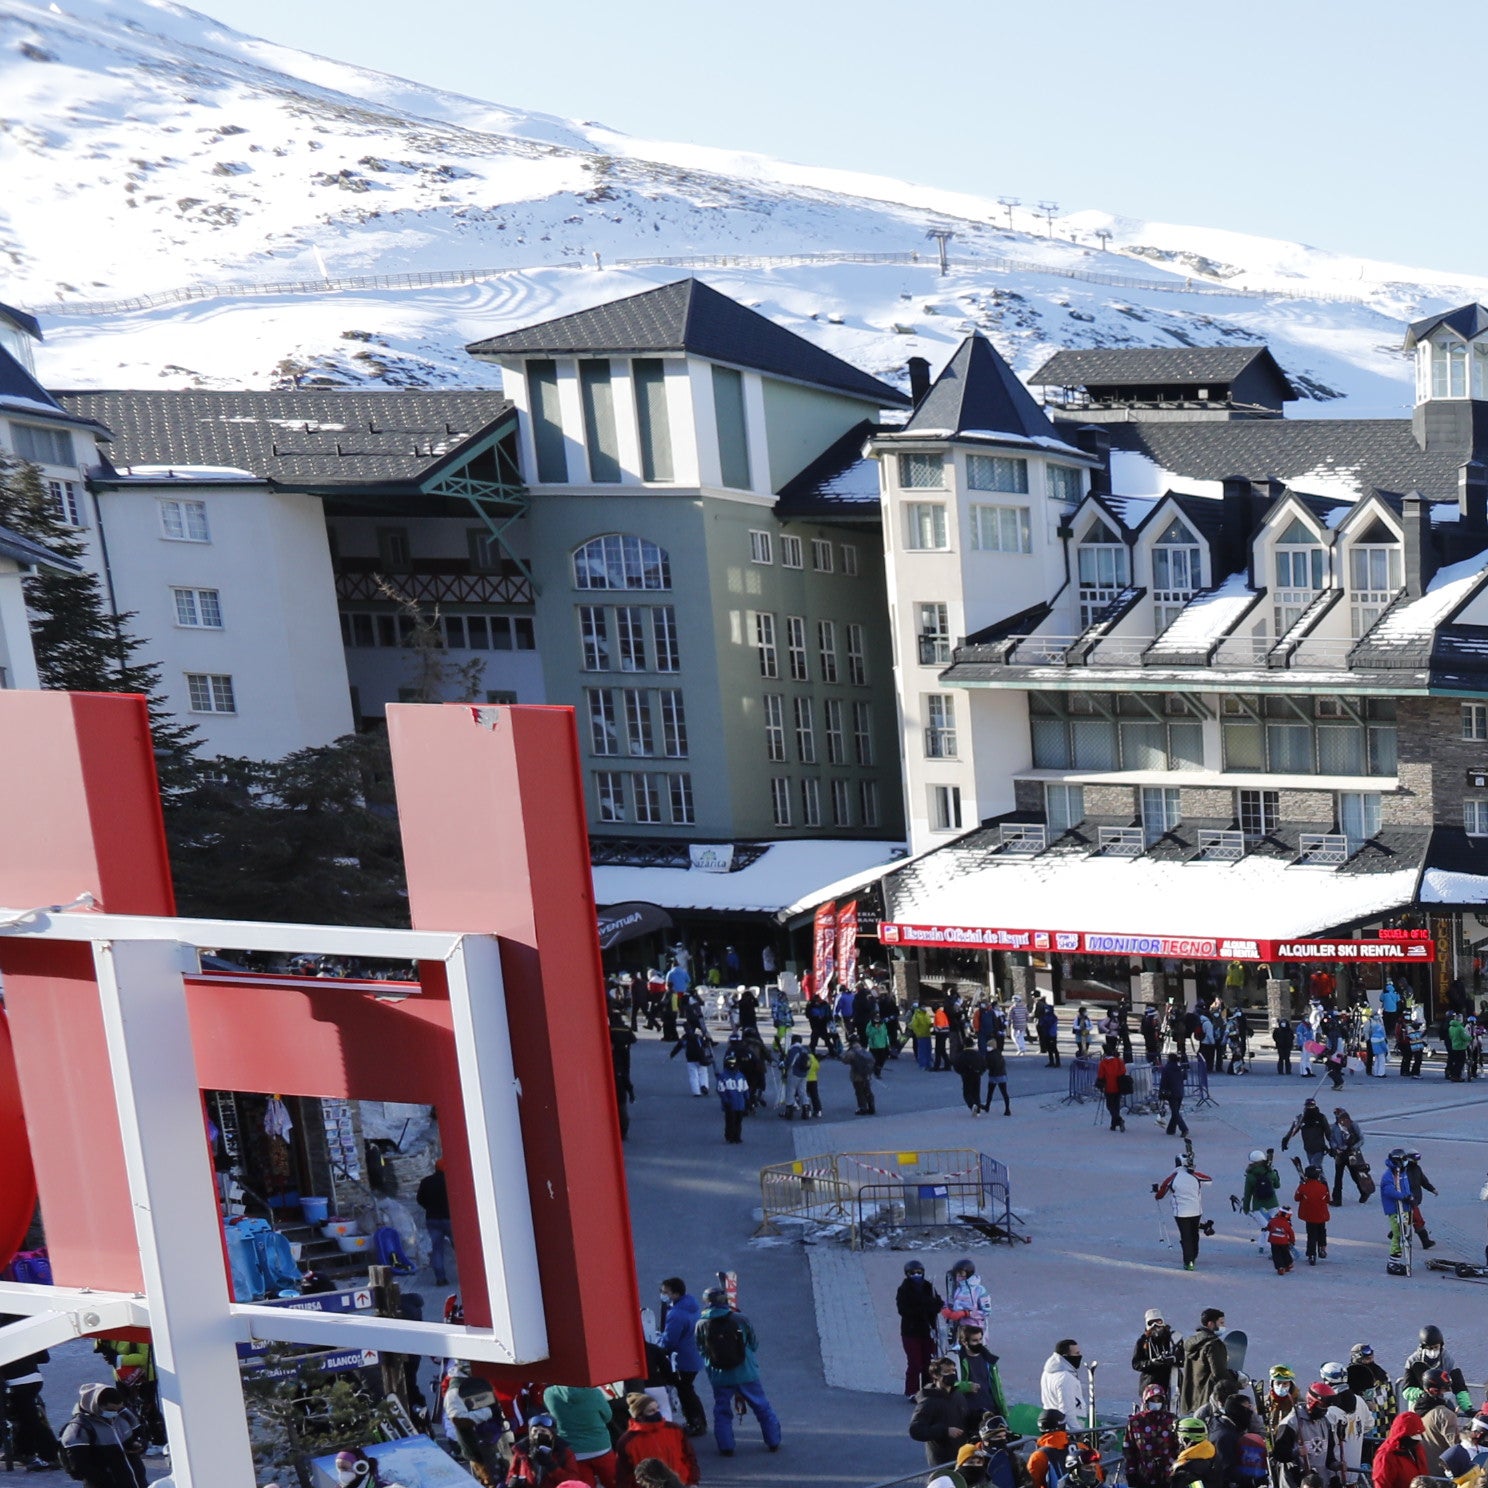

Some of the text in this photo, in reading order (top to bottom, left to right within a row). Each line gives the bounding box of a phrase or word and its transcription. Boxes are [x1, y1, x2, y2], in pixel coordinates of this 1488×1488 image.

[903, 926, 943, 941] Escuela
[943, 928, 982, 943] Oficial
[984, 930, 997, 943] de
[1379, 929, 1409, 939] ESCUELA
[1058, 941, 1077, 950] SHOP
[1223, 940, 1257, 950] ALQUILER
[1220, 948, 1260, 959] SKI RENTAL
[1278, 944, 1405, 957] ALQUILER SKI RENTAL
